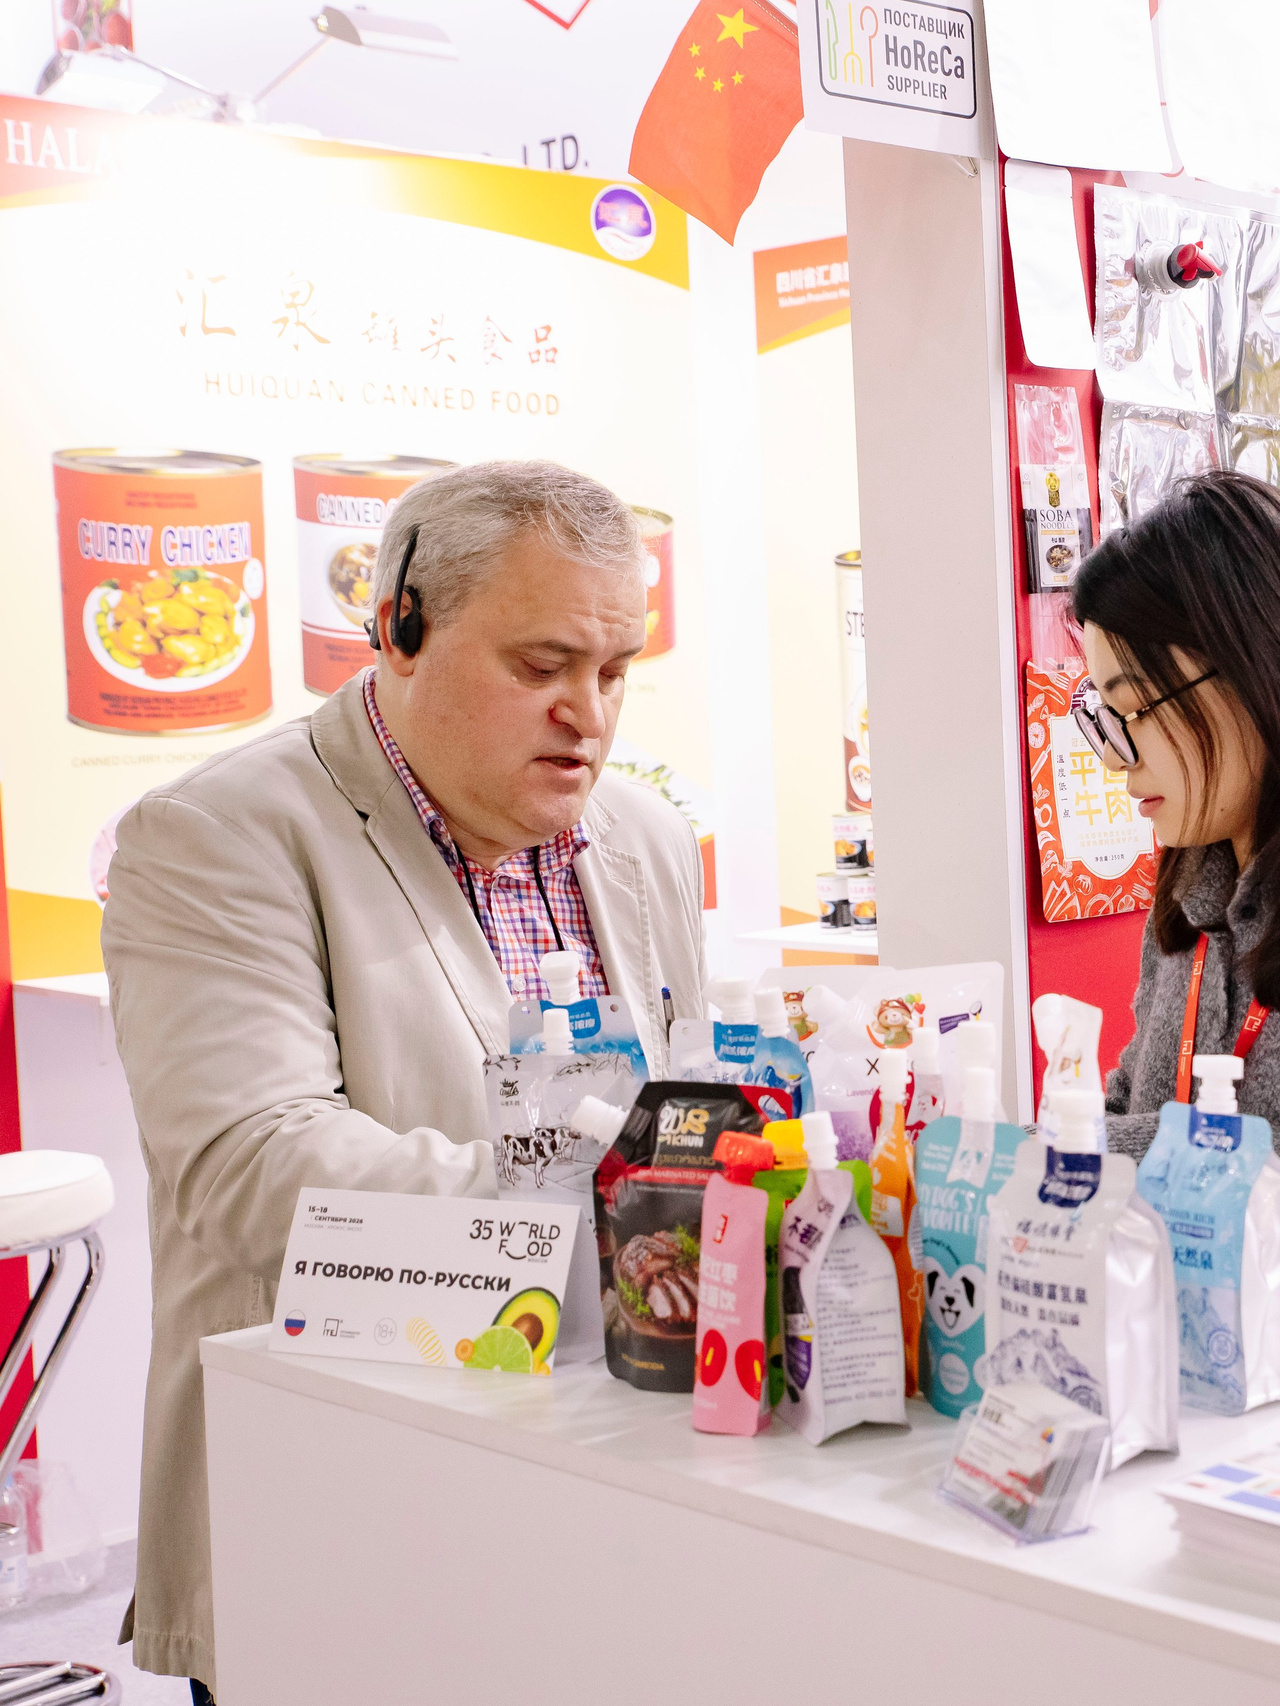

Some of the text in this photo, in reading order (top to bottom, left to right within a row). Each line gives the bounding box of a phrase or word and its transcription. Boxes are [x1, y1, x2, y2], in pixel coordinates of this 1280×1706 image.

[884, 6, 966, 40] ПОСТАВЩИК
[885, 35, 965, 80] HoReCa
[887, 75, 948, 100] SUPPLIER
[204, 371, 560, 416] HUIQUAN CANNED FOOD
[316, 493, 384, 525] CANNED
[1040, 509, 1073, 522] SOBA
[78, 518, 252, 566] CURRY CHICKEN
[1075, 787, 1133, 826] 牛肉
[314, 1215, 347, 1223] СЕНТЯБРЯ
[470, 1219, 494, 1240] 35
[294, 1260, 511, 1292] Я ГОВОРЮ ПО-РУССКИ
[378, 1324, 394, 1338] 18+
